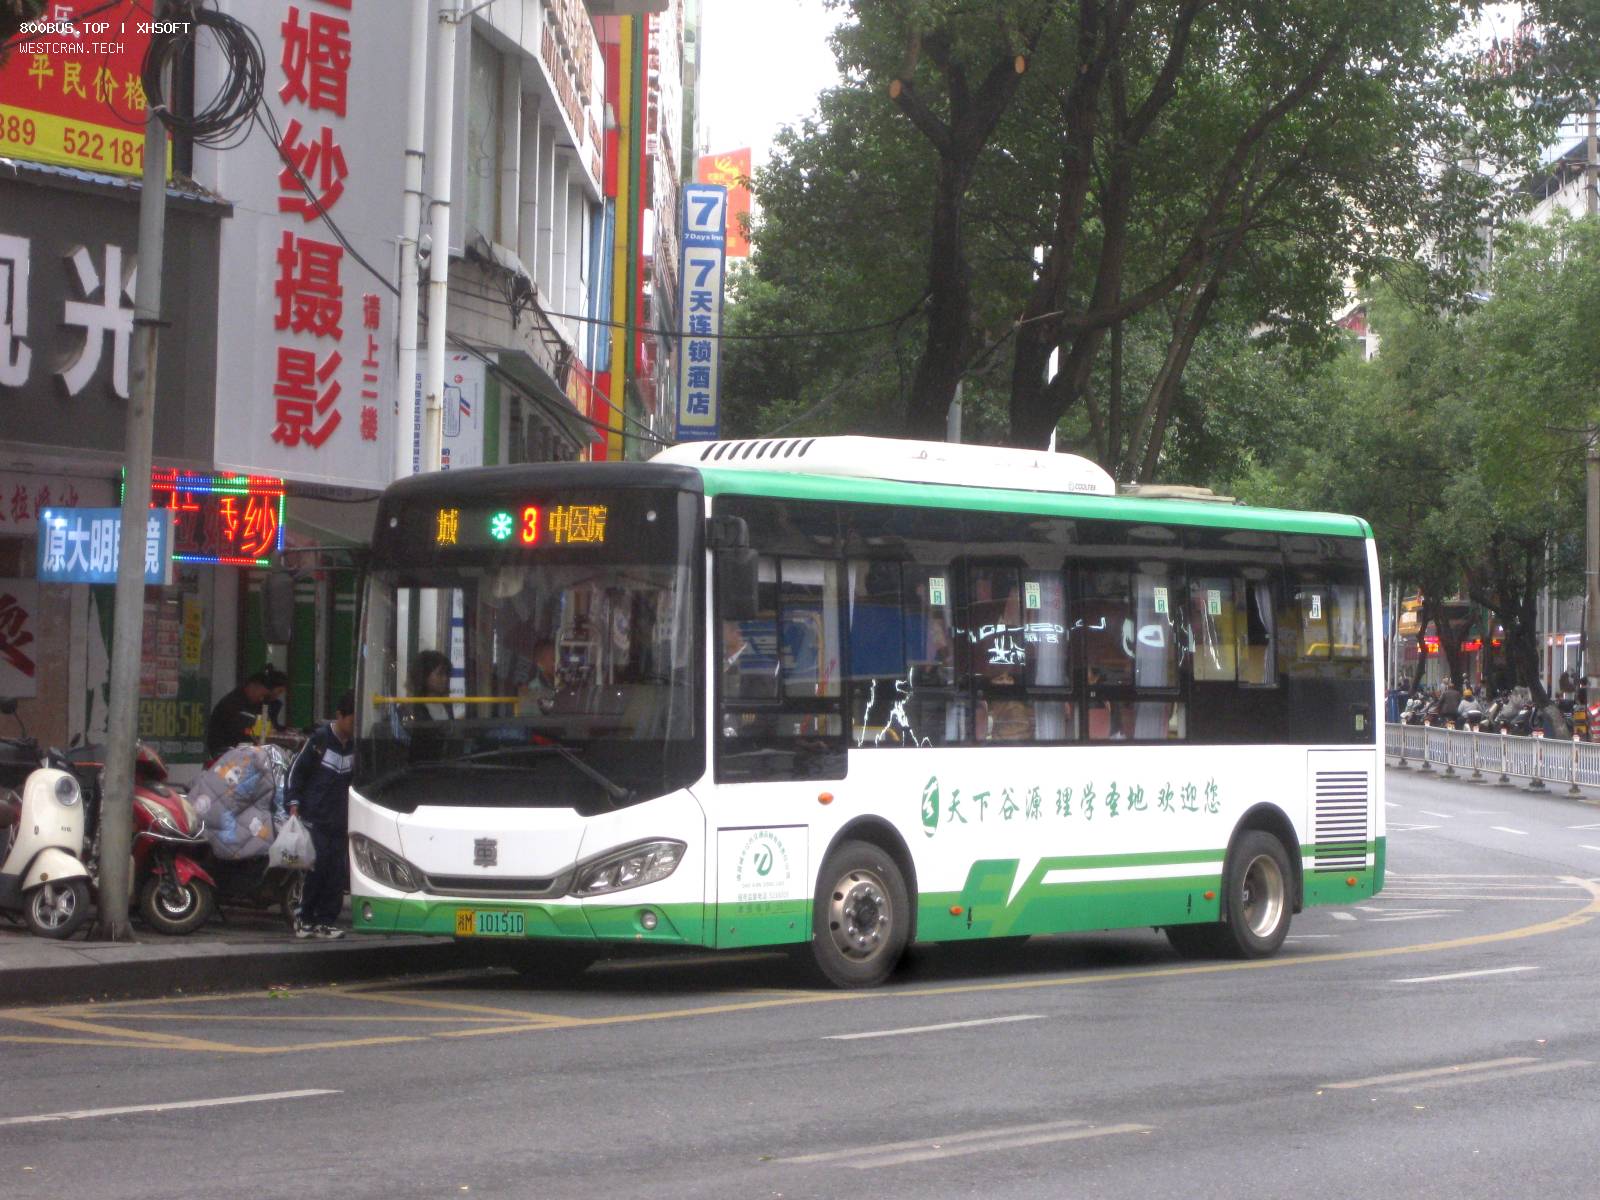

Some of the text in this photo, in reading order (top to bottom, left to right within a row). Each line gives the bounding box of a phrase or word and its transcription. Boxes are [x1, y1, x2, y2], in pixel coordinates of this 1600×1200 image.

[28, 54, 148, 111] 平民价格
[271, 0, 352, 449] 婚纱摄影
[691, 195, 719, 226] 7
[686, 258, 716, 416] 7天连锁酒店
[360, 292, 380, 442] 请上二楼
[43, 516, 160, 574] 原大明镜
[522, 507, 538, 543] 3
[549, 505, 608, 544] 中医院
[479, 914, 525, 933] 10151D
